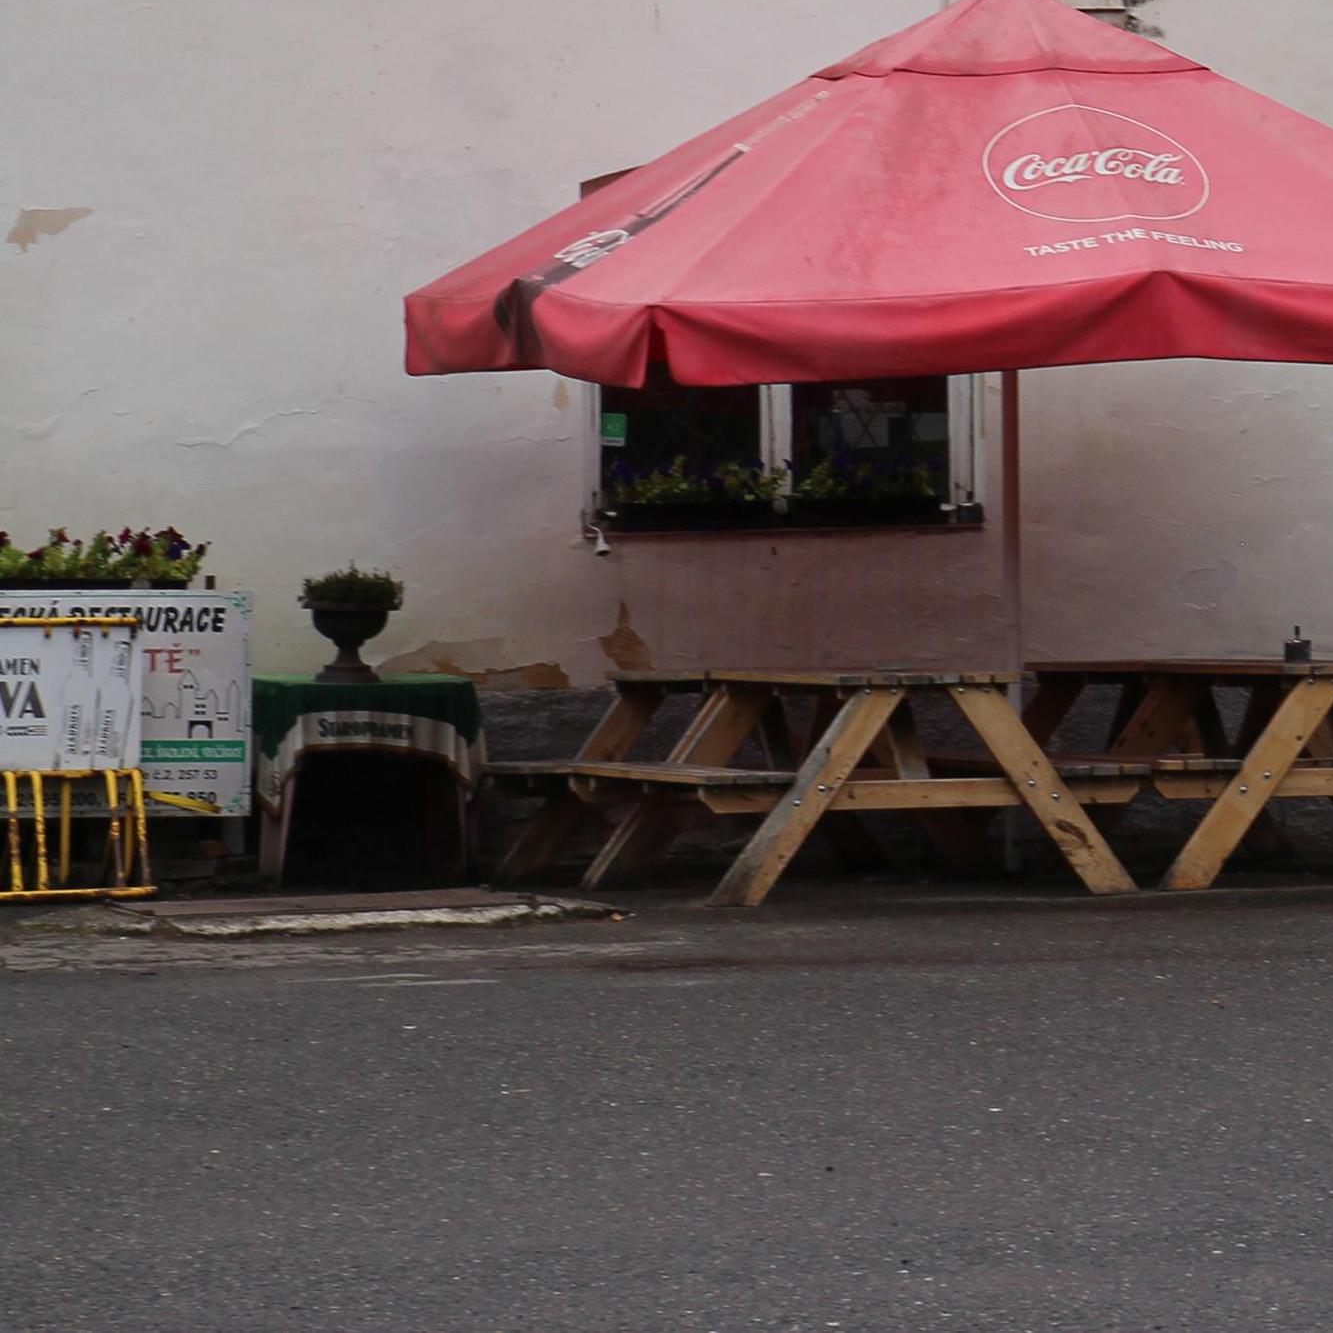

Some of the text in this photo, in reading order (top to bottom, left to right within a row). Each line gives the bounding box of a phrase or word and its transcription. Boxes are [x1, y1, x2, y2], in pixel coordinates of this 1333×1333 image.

[1003, 147, 1185, 190] Coca-Cola
[1024, 227, 1244, 257] TASTE THE FEELING
